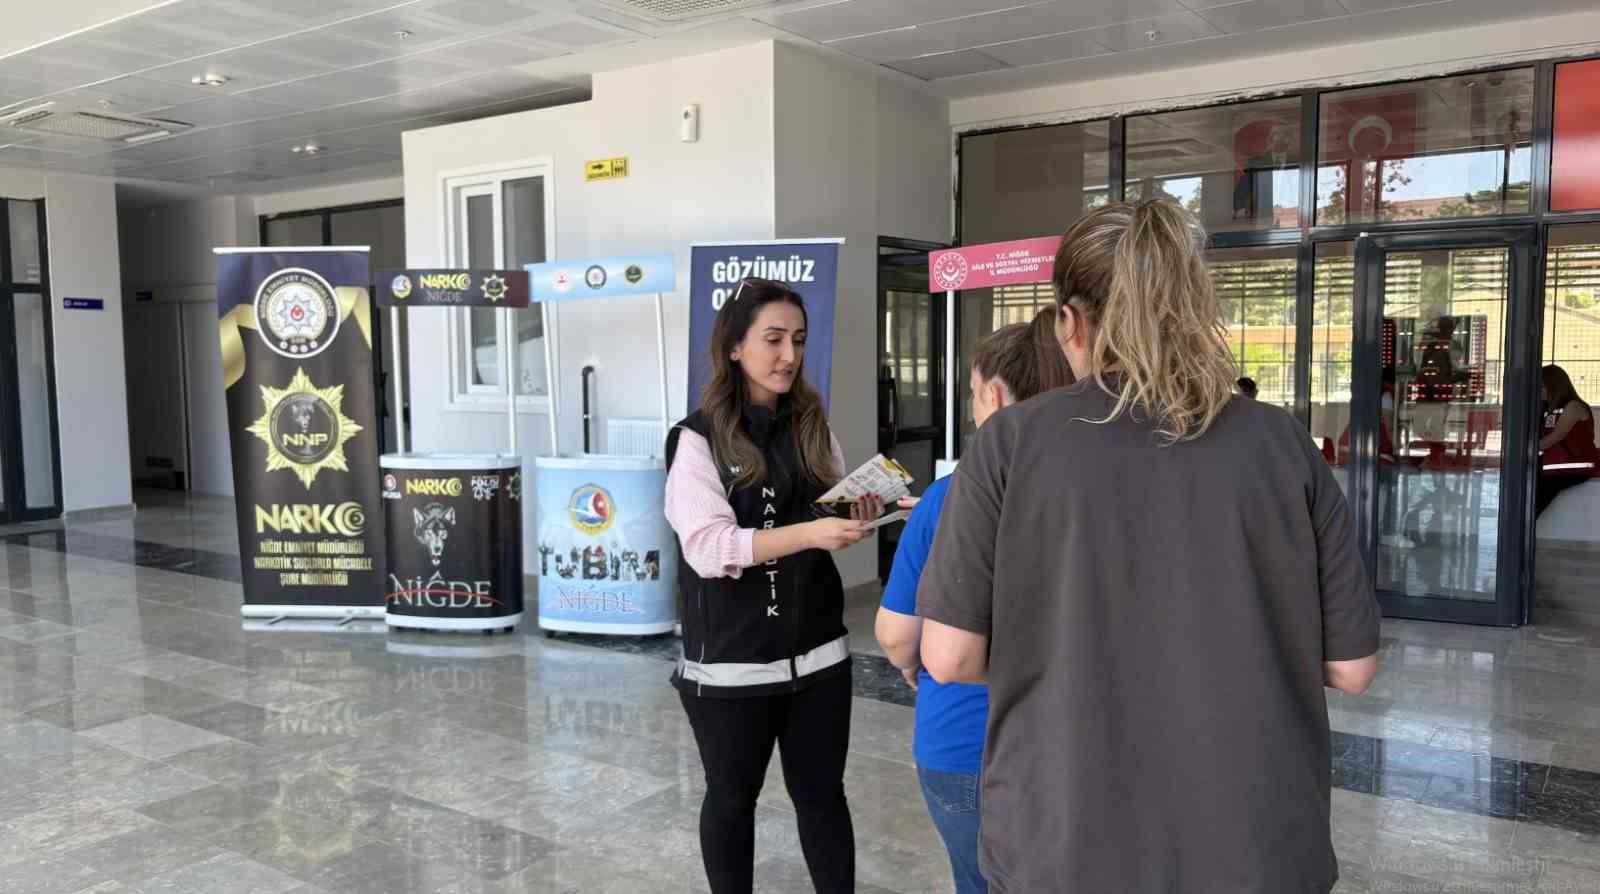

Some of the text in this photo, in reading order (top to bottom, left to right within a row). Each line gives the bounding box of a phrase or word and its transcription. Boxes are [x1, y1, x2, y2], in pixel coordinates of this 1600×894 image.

[712, 255, 816, 283] GÖZÜMÜZ
[282, 433, 329, 446] NNP
[761, 487, 780, 617] NARTİK
